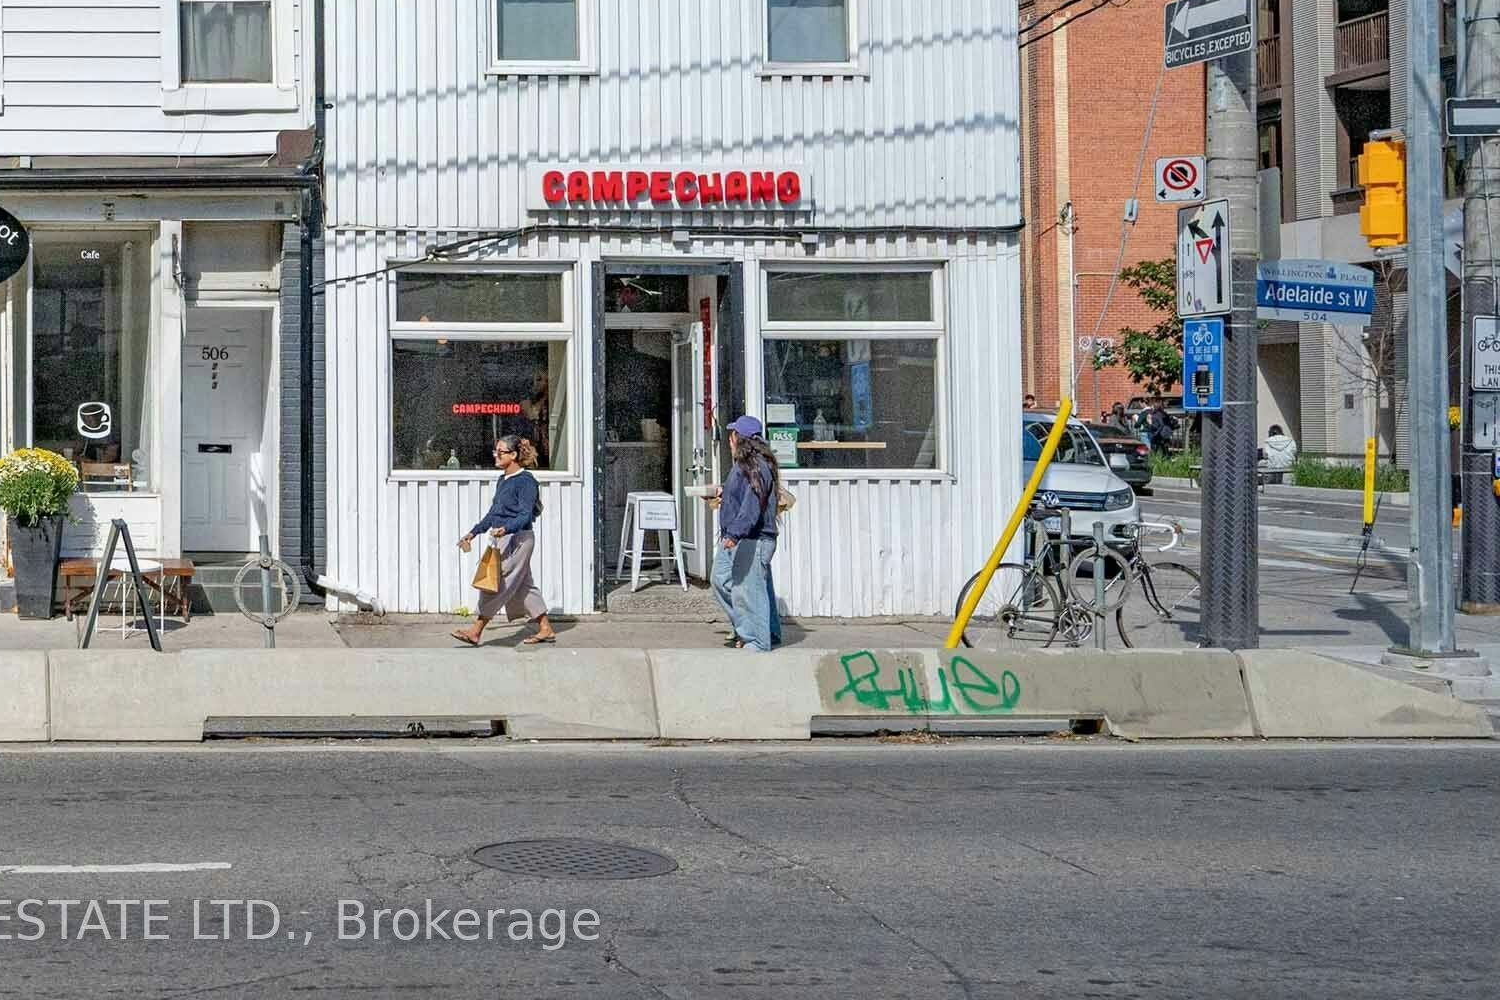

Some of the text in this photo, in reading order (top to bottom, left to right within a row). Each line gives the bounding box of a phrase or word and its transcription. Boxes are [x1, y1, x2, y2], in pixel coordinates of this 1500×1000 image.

[1166, 31, 1251, 64] BICYCLES EXCEPTED
[542, 170, 800, 205] CAMPECHANO
[80, 249, 100, 260] Cafe
[1263, 267, 1323, 279] WELLINGTON
[1264, 283, 1368, 307] Adelaide St W
[1303, 311, 1328, 321] 504
[202, 346, 229, 361] 506
[1481, 376, 1500, 387] LAN
[452, 403, 521, 414] CAMPECHANO
[772, 432, 794, 441] PASS
